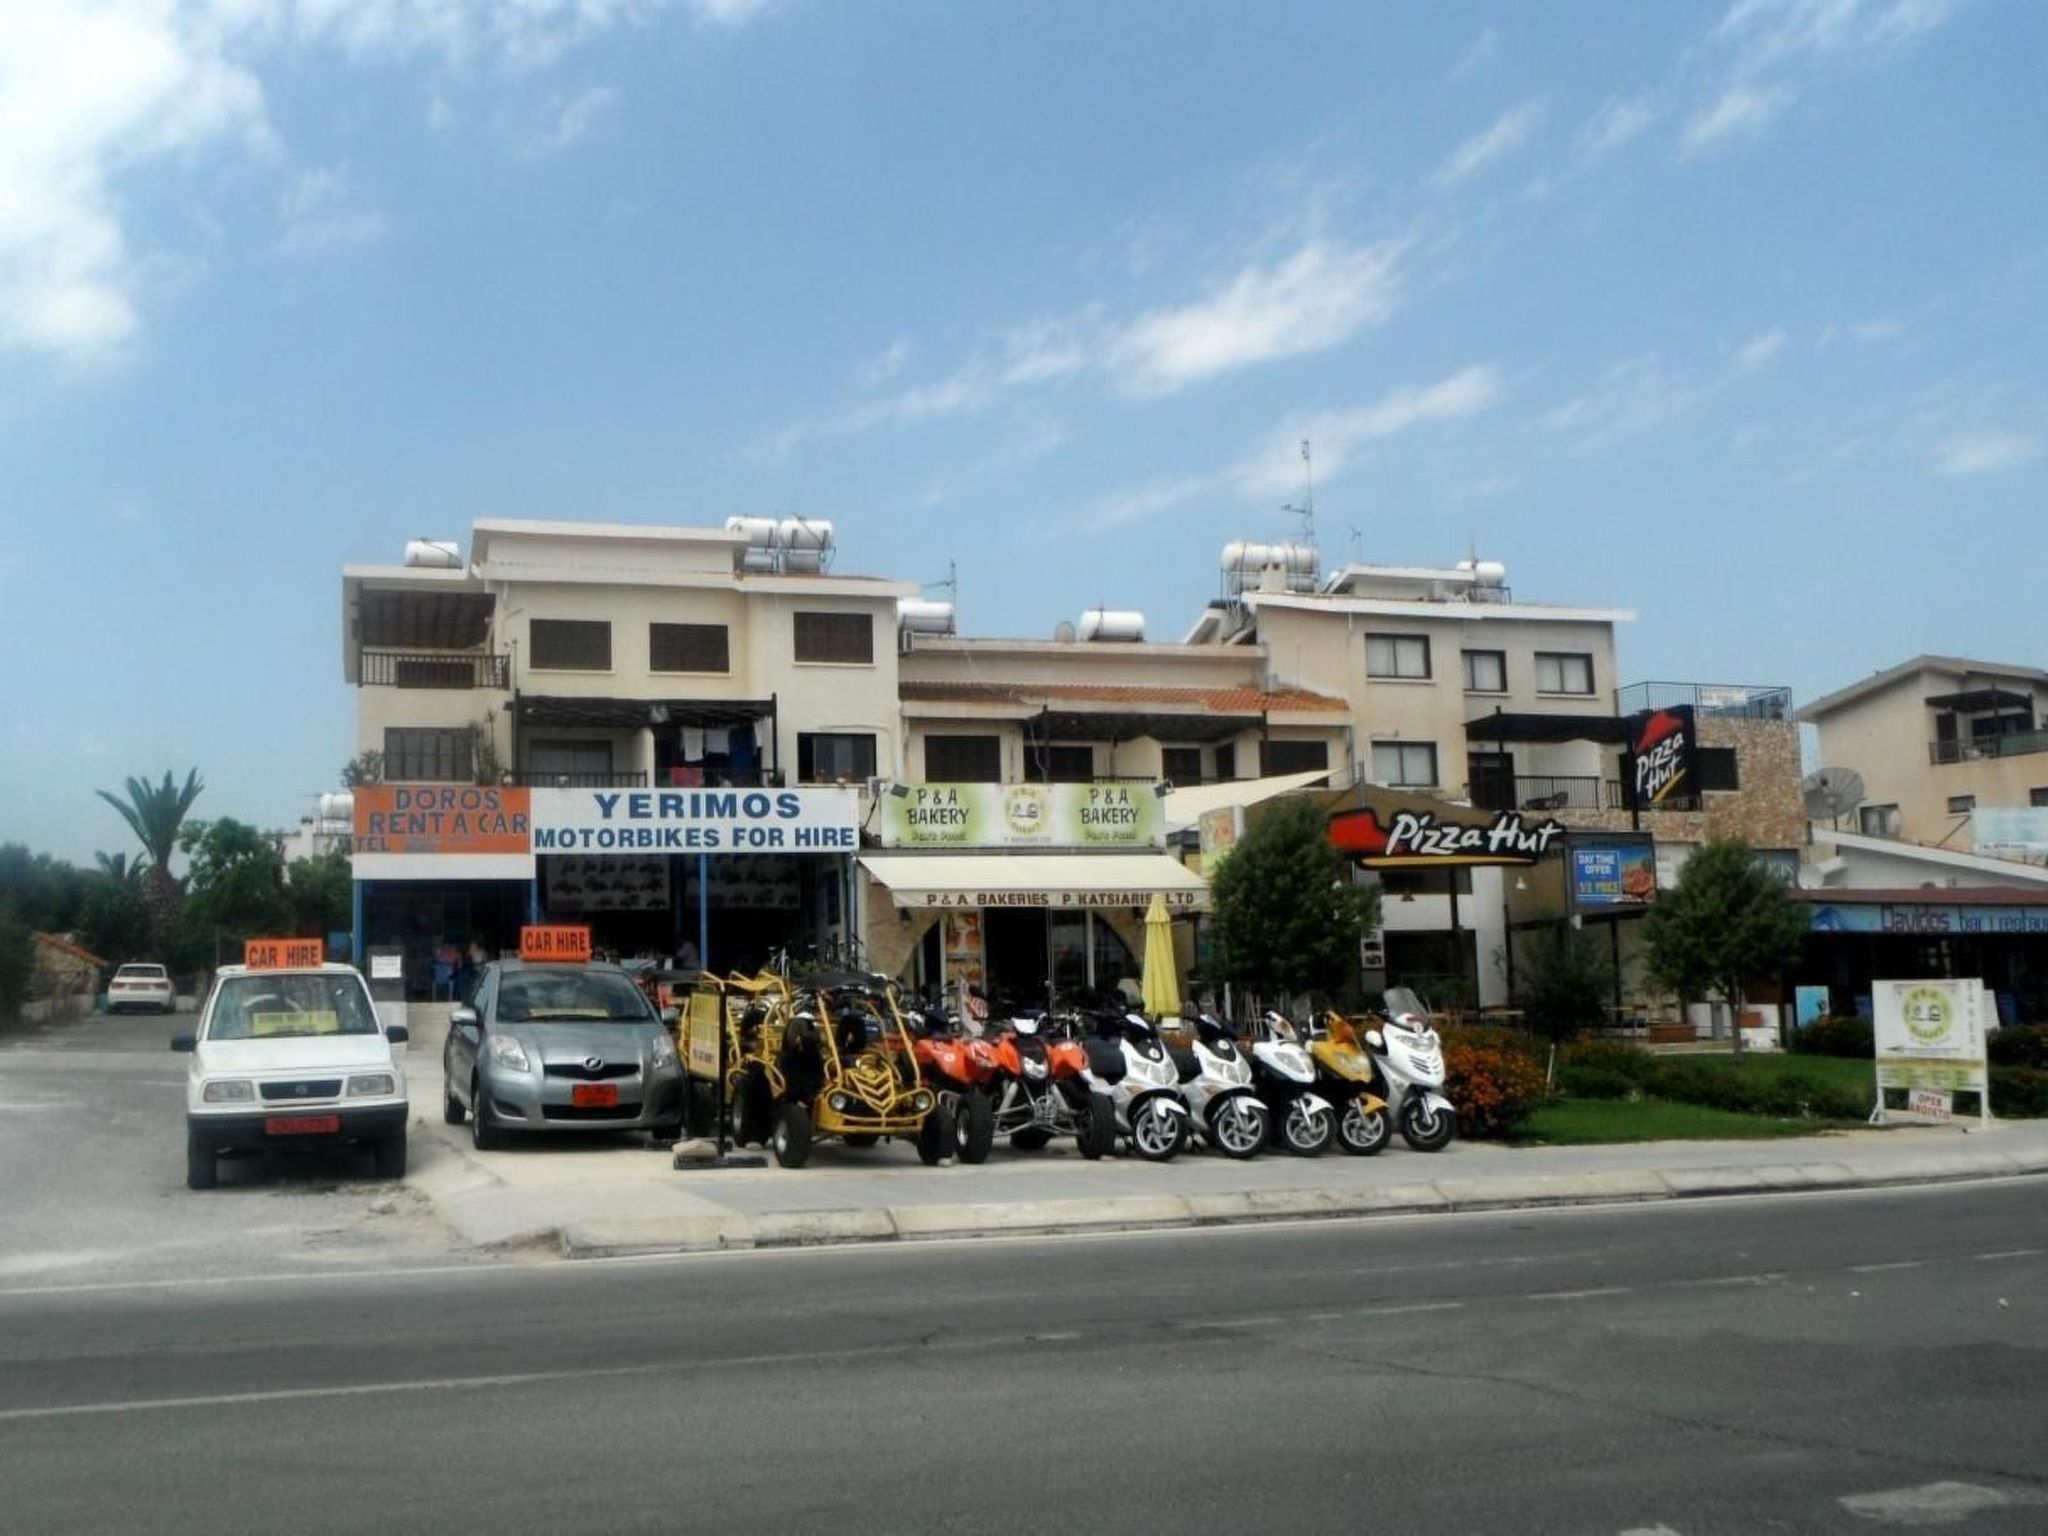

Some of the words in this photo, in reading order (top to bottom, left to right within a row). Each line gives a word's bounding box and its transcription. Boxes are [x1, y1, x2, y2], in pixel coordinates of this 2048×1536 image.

[1636, 732, 1684, 793] Pizza
[1645, 755, 1682, 799] Hut
[396, 788, 500, 811] DOROS
[593, 792, 801, 819] YERIMOS
[916, 788, 928, 805] P
[932, 788, 941, 805] &
[947, 788, 958, 805] A
[1089, 787, 1099, 804] P
[1103, 787, 1114, 804] &
[1118, 787, 1129, 804] A
[368, 811, 445, 835] RENT
[452, 811, 469, 834] A
[478, 811, 528, 834] CAR
[906, 807, 970, 825] BAKERY
[1079, 807, 1139, 825] BAKERY
[534, 827, 721, 849] MOTORBIKES
[731, 827, 785, 849] FOR
[794, 827, 856, 848] HIRE
[1384, 813, 1484, 857] Pizza
[1486, 815, 1566, 852] Hut
[1584, 865, 1612, 875] OFFER
[926, 893, 937, 906] P
[941, 894, 951, 906] &
[956, 893, 969, 906] A
[976, 893, 1050, 905] BAKERIES
[1165, 893, 1195, 905] LTD
[524, 930, 552, 953] CAR
[556, 929, 587, 952] HIRE
[249, 946, 278, 968] CAR
[286, 944, 320, 967] HIRE
